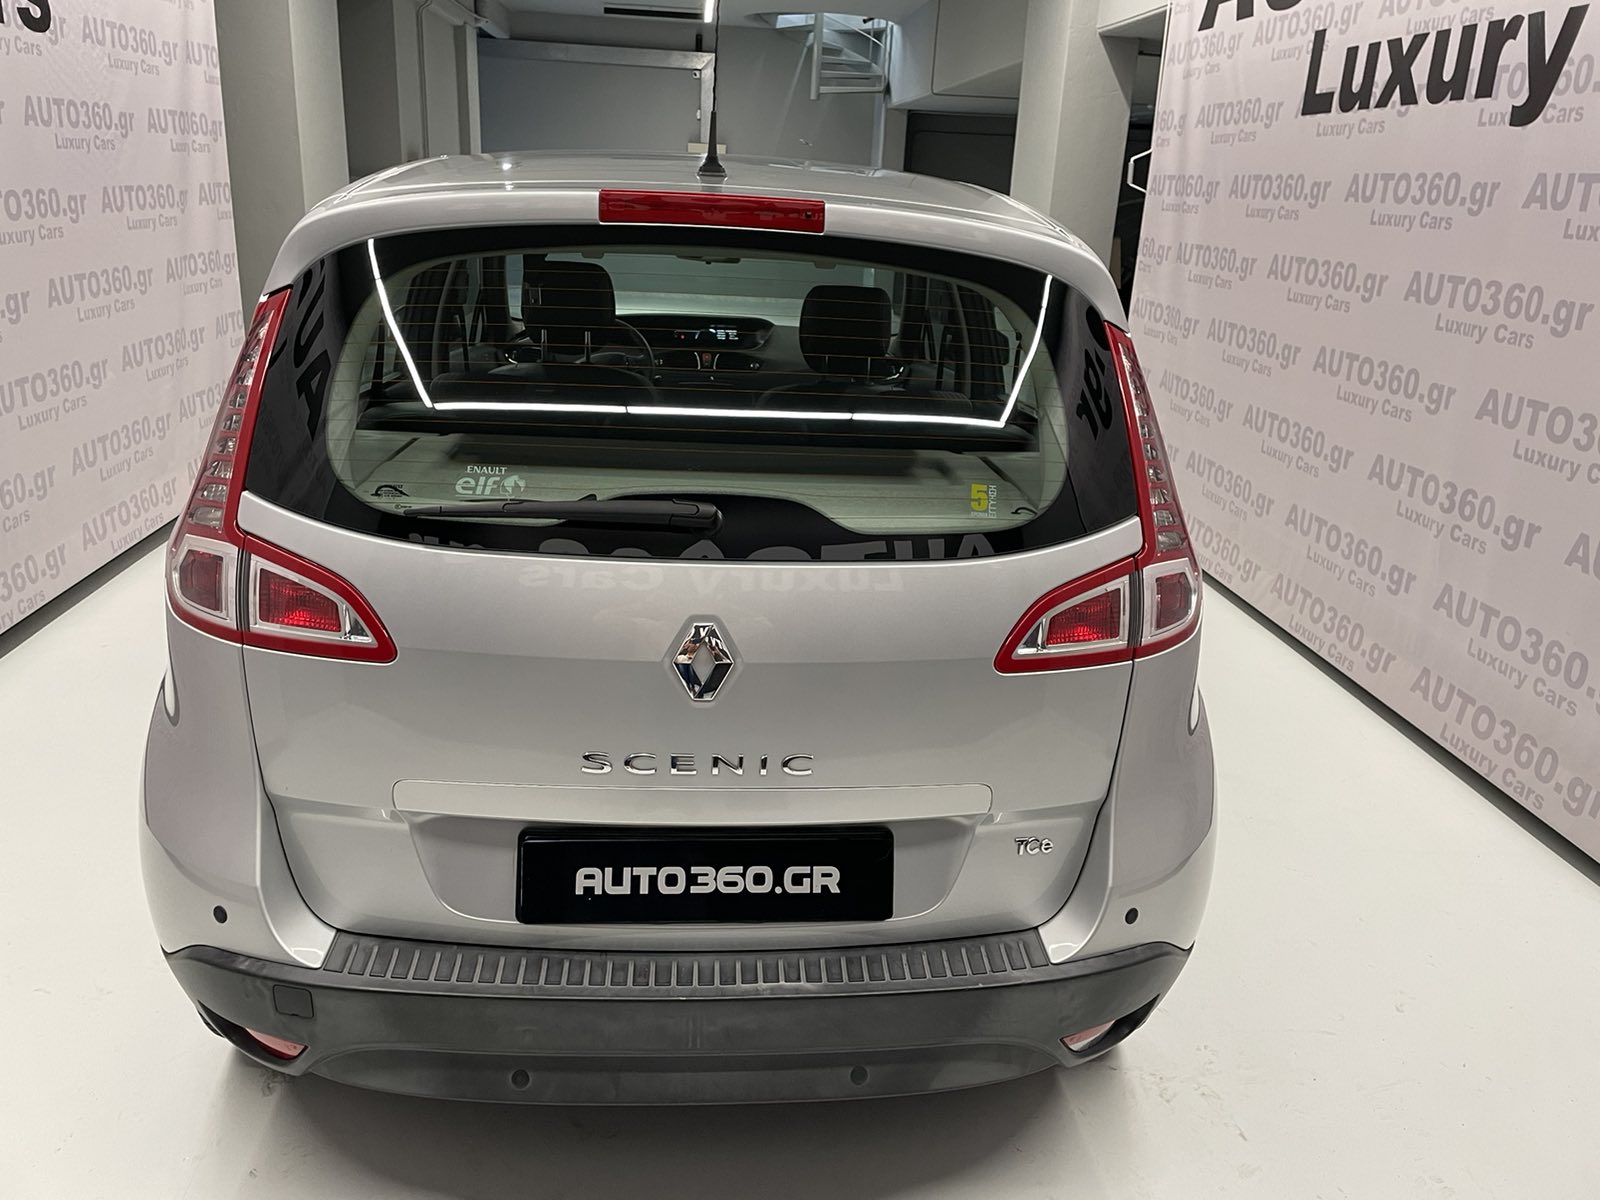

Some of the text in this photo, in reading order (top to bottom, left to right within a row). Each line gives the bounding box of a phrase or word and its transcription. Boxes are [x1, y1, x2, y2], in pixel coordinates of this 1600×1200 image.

[1252, 1, 1364, 48] AUTO360.gr
[1459, 6, 1495, 26] Cars
[15, 36, 42, 56] Cars
[82, 15, 178, 66] AUTO360.gr
[1271, 44, 1303, 63] Luxury
[107, 52, 160, 76] Luxury Cars
[1301, 4, 1590, 127] Luxury
[24, 95, 135, 139] AUTO360.gr
[1195, 97, 1284, 128] AUTO360.gr
[1316, 118, 1386, 139] Luxury Cars
[1542, 103, 1584, 124] Cars
[55, 133, 116, 153] Luxury Cars
[1211, 129, 1257, 146] Luxury Cars
[0, 187, 87, 224] O360.gr
[102, 183, 188, 214] AUTO360.gr
[1229, 174, 1331, 209] AUTO360.gr
[1344, 172, 1501, 217] AUTO360.gr
[1521, 172, 1600, 213] AUT
[38, 223, 64, 241] Cars
[126, 213, 178, 232] Luxury Cars
[1245, 204, 1299, 222] Luxury Cars
[1370, 209, 1453, 232] Luxury Cars
[166, 250, 236, 284] AUTO360.gr
[1176, 242, 1257, 281] AUTO360.gr
[1188, 270, 1232, 290] Luxury Cars
[1266, 253, 1389, 303] AUTO360.gr
[48, 265, 153, 309] AUTO360.gr
[1287, 287, 1350, 313] Luxury Cars
[1403, 270, 1595, 338] AUTO360.gr
[77, 299, 135, 322] Luxury Cars
[121, 326, 205, 372] AUTO360.gr
[1206, 318, 1302, 371] AUTO360.gr
[1435, 313, 1535, 349] Luxury Cars
[145, 361, 175, 382] Luxury
[1222, 349, 1272, 377] Luxury Cars
[1312, 345, 1457, 415] AUTO360.gr
[0, 358, 108, 417] UTO360.gr
[179, 380, 226, 423] AUTO3
[1159, 369, 1233, 422] AUTO360.gr
[1336, 384, 1412, 423] Luxury Cars
[17, 395, 88, 431] Luxury Cars
[1169, 399, 1192, 422] Luxury
[1474, 388, 1600, 455] AUTO3
[72, 412, 172, 477] AUTO360.gr
[1242, 403, 1354, 474] AUTO360.gr
[100, 445, 154, 482] Luxury Cars
[1261, 439, 1320, 479] Luxury Cars
[1512, 439, 1582, 482] Luxury
[455, 476, 501, 495] elf
[970, 484, 988, 511] 5
[1186, 450, 1275, 518] AUTO360.gr
[1202, 483, 1248, 521] Luxury Cars
[1367, 453, 1542, 551] AUTO360.gr
[2, 509, 31, 533] Cars
[82, 477, 177, 551] AUTO360.gr
[110, 512, 164, 554] Luxury Cars
[1396, 500, 1487, 555] Luxury Cars
[1285, 503, 1417, 596] AUTO360.gr
[1214, 561, 1233, 584] Cars
[1307, 545, 1376, 598] Luxury Cars
[17, 589, 46, 616] Cars
[1270, 573, 1397, 674] AUTO360.gr
[1288, 614, 1354, 672] Luxury Cars
[1433, 583, 1600, 716] AUTO360.
[1467, 638, 1577, 717] Luxury Cars
[580, 752, 816, 776] SCENIC
[1440, 722, 1545, 811] Luxury Cars
[1014, 836, 1054, 856] TCe
[575, 864, 841, 895] AUTO360.GR
